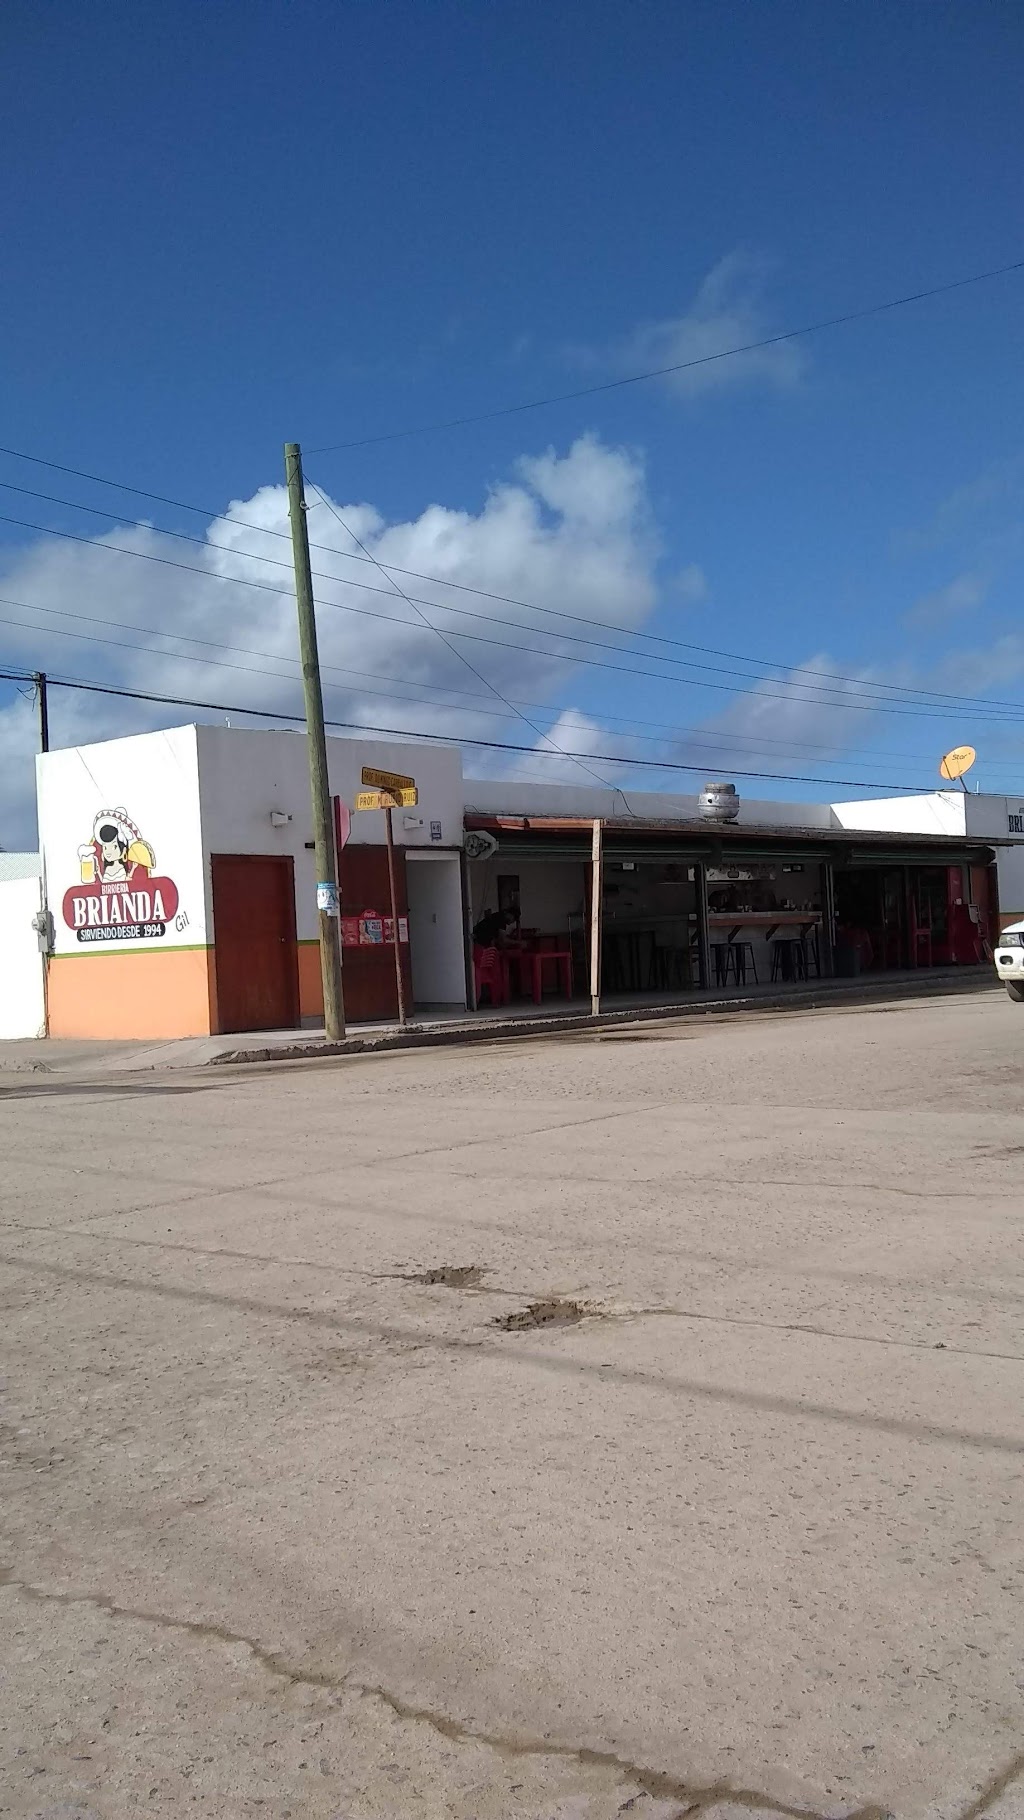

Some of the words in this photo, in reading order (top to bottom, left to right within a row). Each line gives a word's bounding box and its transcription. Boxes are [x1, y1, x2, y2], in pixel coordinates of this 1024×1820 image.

[1008, 815, 1024, 832] BRI
[73, 890, 167, 927] BRIANDA
[118, 925, 140, 938] DESDE
[144, 924, 162, 936] 1994
[175, 911, 190, 932] Gil
